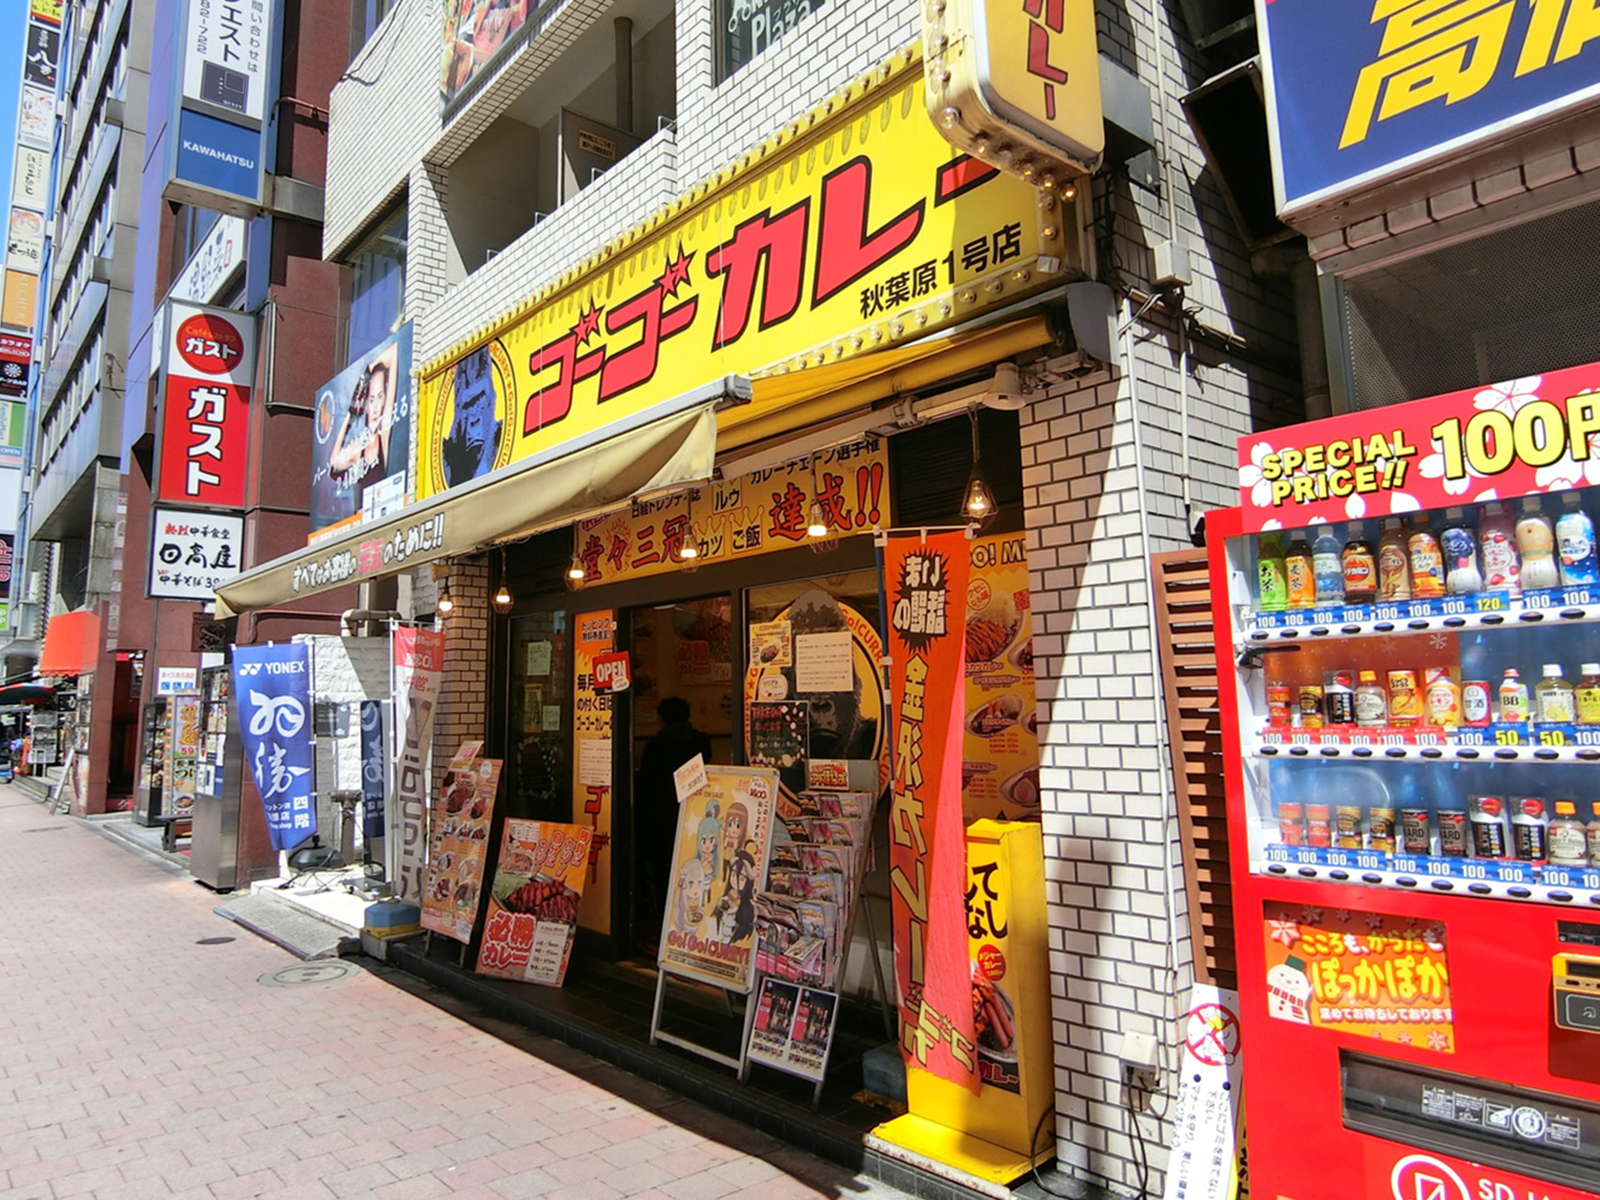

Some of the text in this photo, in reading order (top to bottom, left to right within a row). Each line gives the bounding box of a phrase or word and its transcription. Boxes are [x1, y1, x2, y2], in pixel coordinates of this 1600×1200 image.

[219, 0, 242, 62] エスト
[183, 139, 254, 169] KAWAHATSU
[860, 222, 1022, 319] 秋葉原1号店
[523, 155, 1002, 438] ゴーゴーカレー
[185, 337, 238, 360] ガスト
[187, 387, 227, 497] ガスト
[1262, 429, 1417, 479] SPECIAL
[1272, 458, 1409, 506] PRICE!!
[159, 542, 237, 569] 日高屋
[1260, 566, 1274, 592] お茶
[264, 660, 305, 675] YONEX
[596, 659, 627, 683] OPEN
[1464, 698, 1485, 708] 甘酒
[1502, 696, 1520, 706] BB
[293, 795, 310, 829] 四階
[487, 910, 537, 949] 必勝
[1302, 929, 1444, 954] こころも、からだも
[481, 940, 530, 970] カレー
[1311, 955, 1449, 999] ぽっかぽか
[1319, 1007, 1454, 1022] 温めてお待ちしております
